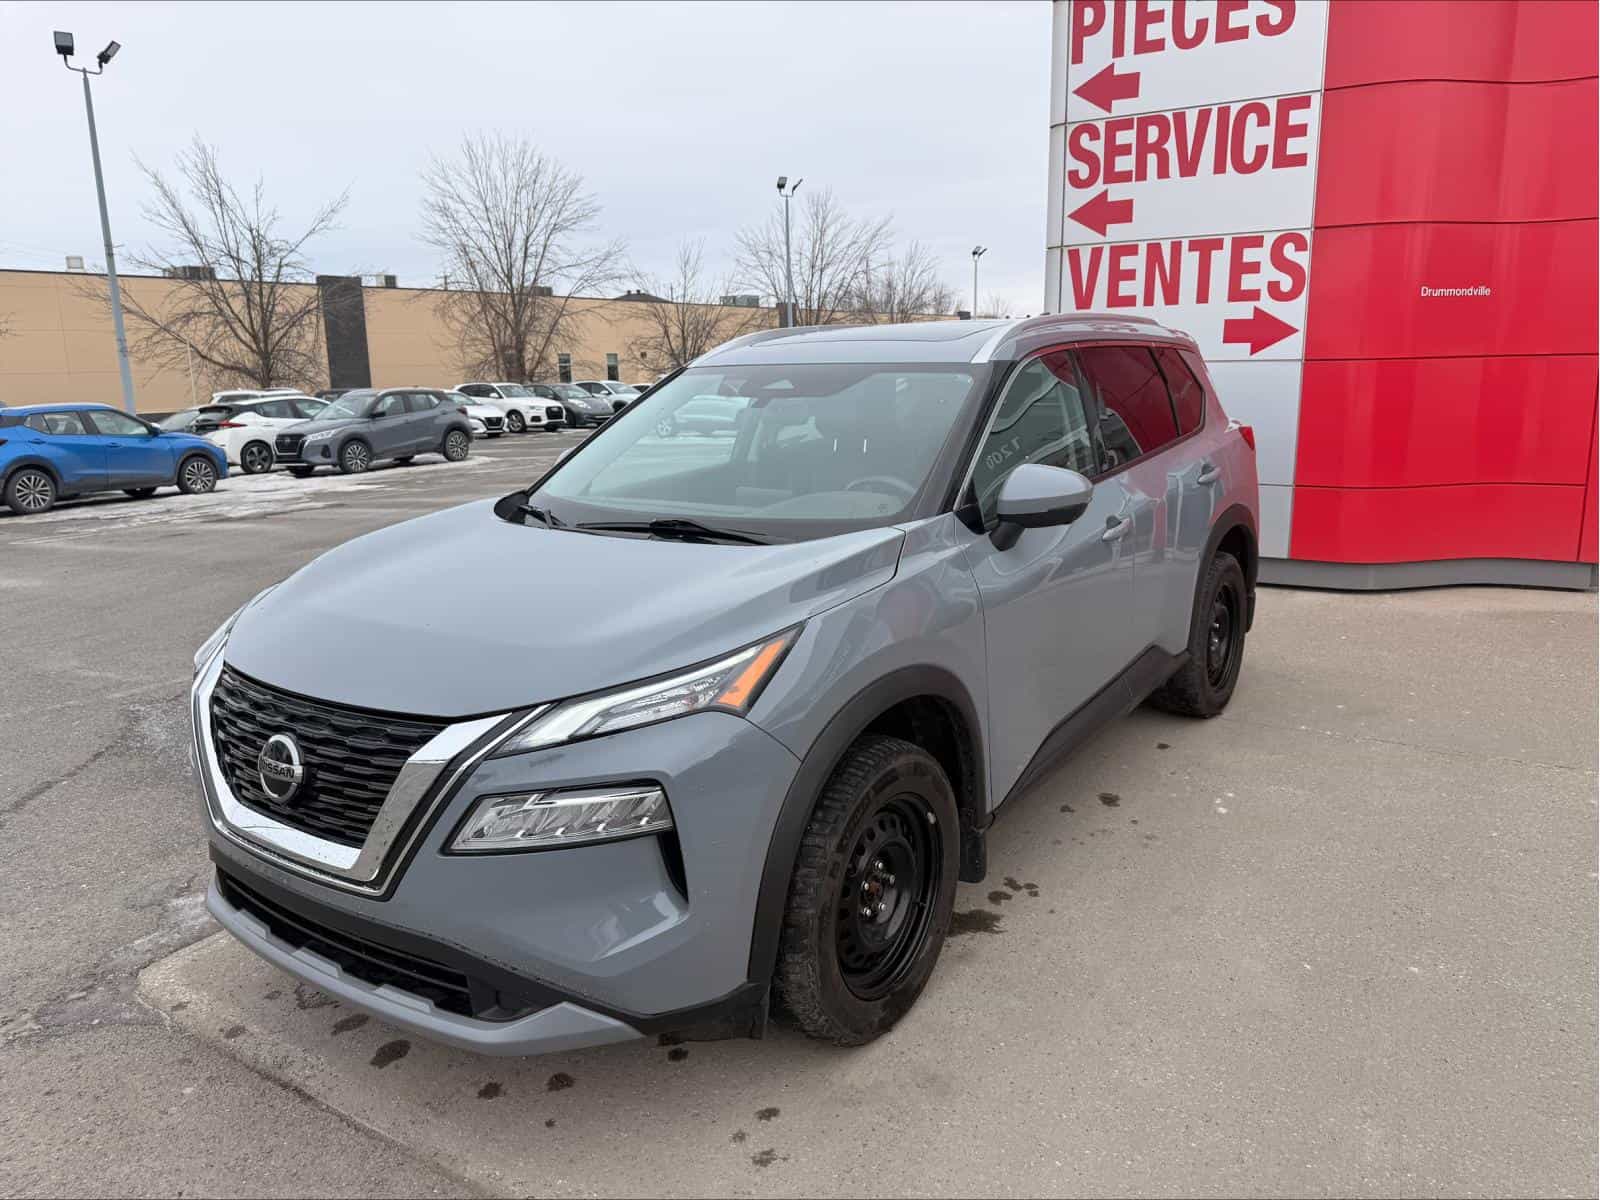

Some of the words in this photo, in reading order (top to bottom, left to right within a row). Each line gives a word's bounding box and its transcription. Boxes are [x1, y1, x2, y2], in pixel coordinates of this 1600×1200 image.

[1067, 95, 1312, 189] SERVICE
[1067, 232, 1309, 310] VENTES
[1420, 285, 1491, 297] Drummondville
